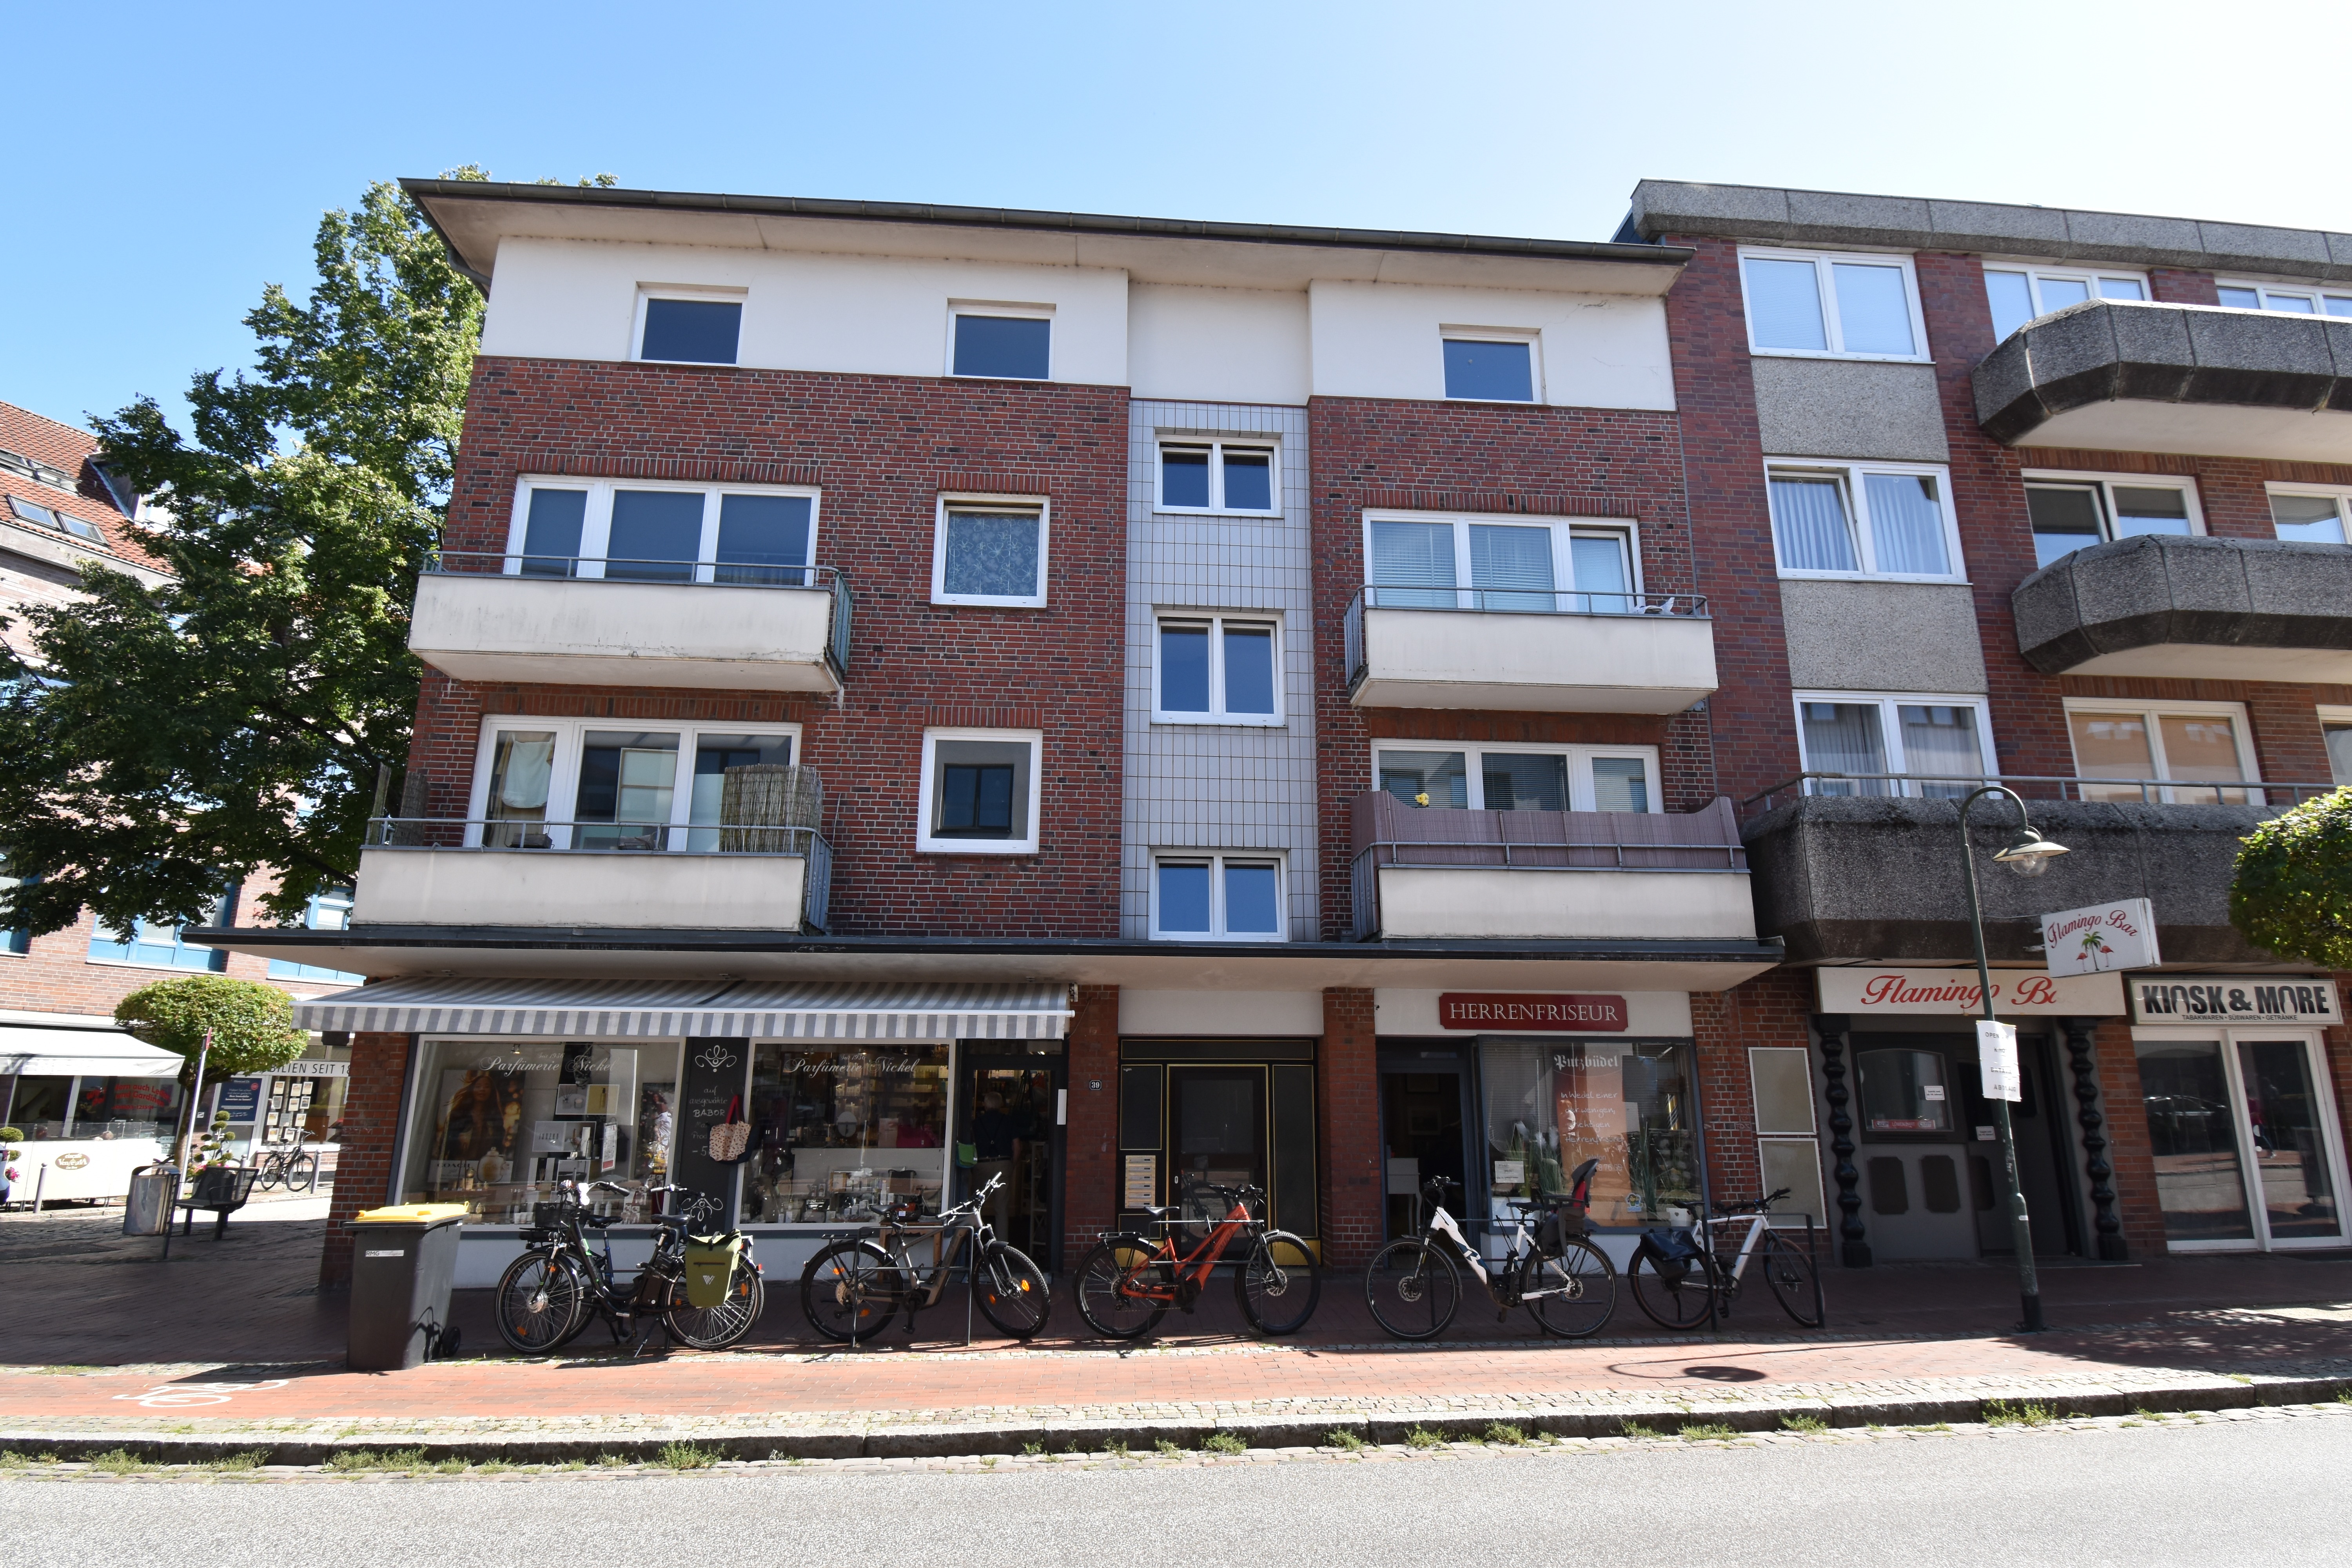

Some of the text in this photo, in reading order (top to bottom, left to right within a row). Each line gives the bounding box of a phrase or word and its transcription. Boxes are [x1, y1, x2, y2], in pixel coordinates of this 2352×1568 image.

[2047, 910, 2138, 949] Flamingo Bar
[1449, 1003, 1619, 1021] HERRENFRISEUR
[312, 1063, 336, 1074] SEIT
[479, 1054, 620, 1077] Parfümerie Nickel
[783, 1056, 920, 1078] Parfümerie Nickel
[1553, 1054, 1619, 1071] Putzbüdel
[704, 1085, 718, 1096] auf
[693, 1109, 725, 1118] BABOR
[1581, 1108, 1616, 1118] wenigen,
